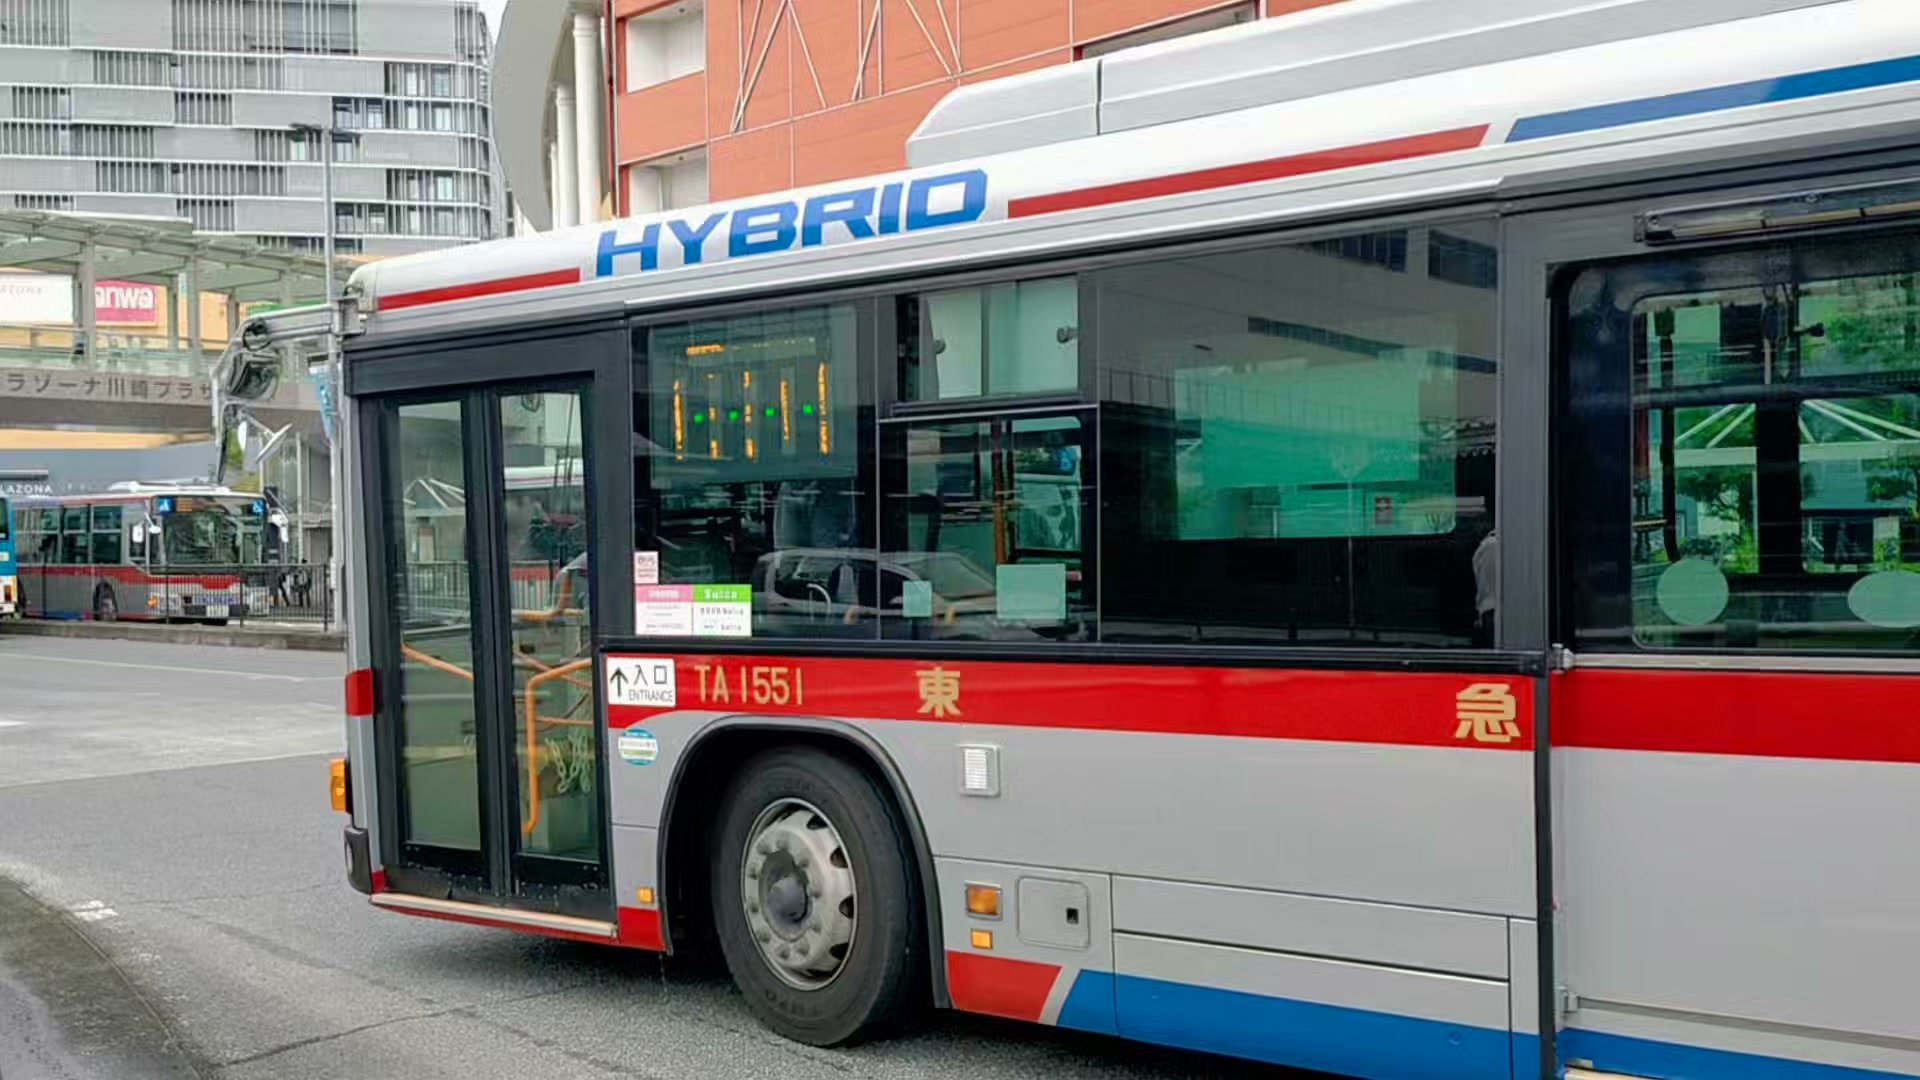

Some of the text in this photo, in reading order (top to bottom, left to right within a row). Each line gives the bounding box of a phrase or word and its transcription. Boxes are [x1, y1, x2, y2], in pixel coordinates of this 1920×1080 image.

[596, 168, 988, 277] HYBRID
[95, 286, 154, 308] anwa
[633, 664, 668, 686] 入口
[628, 689, 673, 702] ENTRANCE
